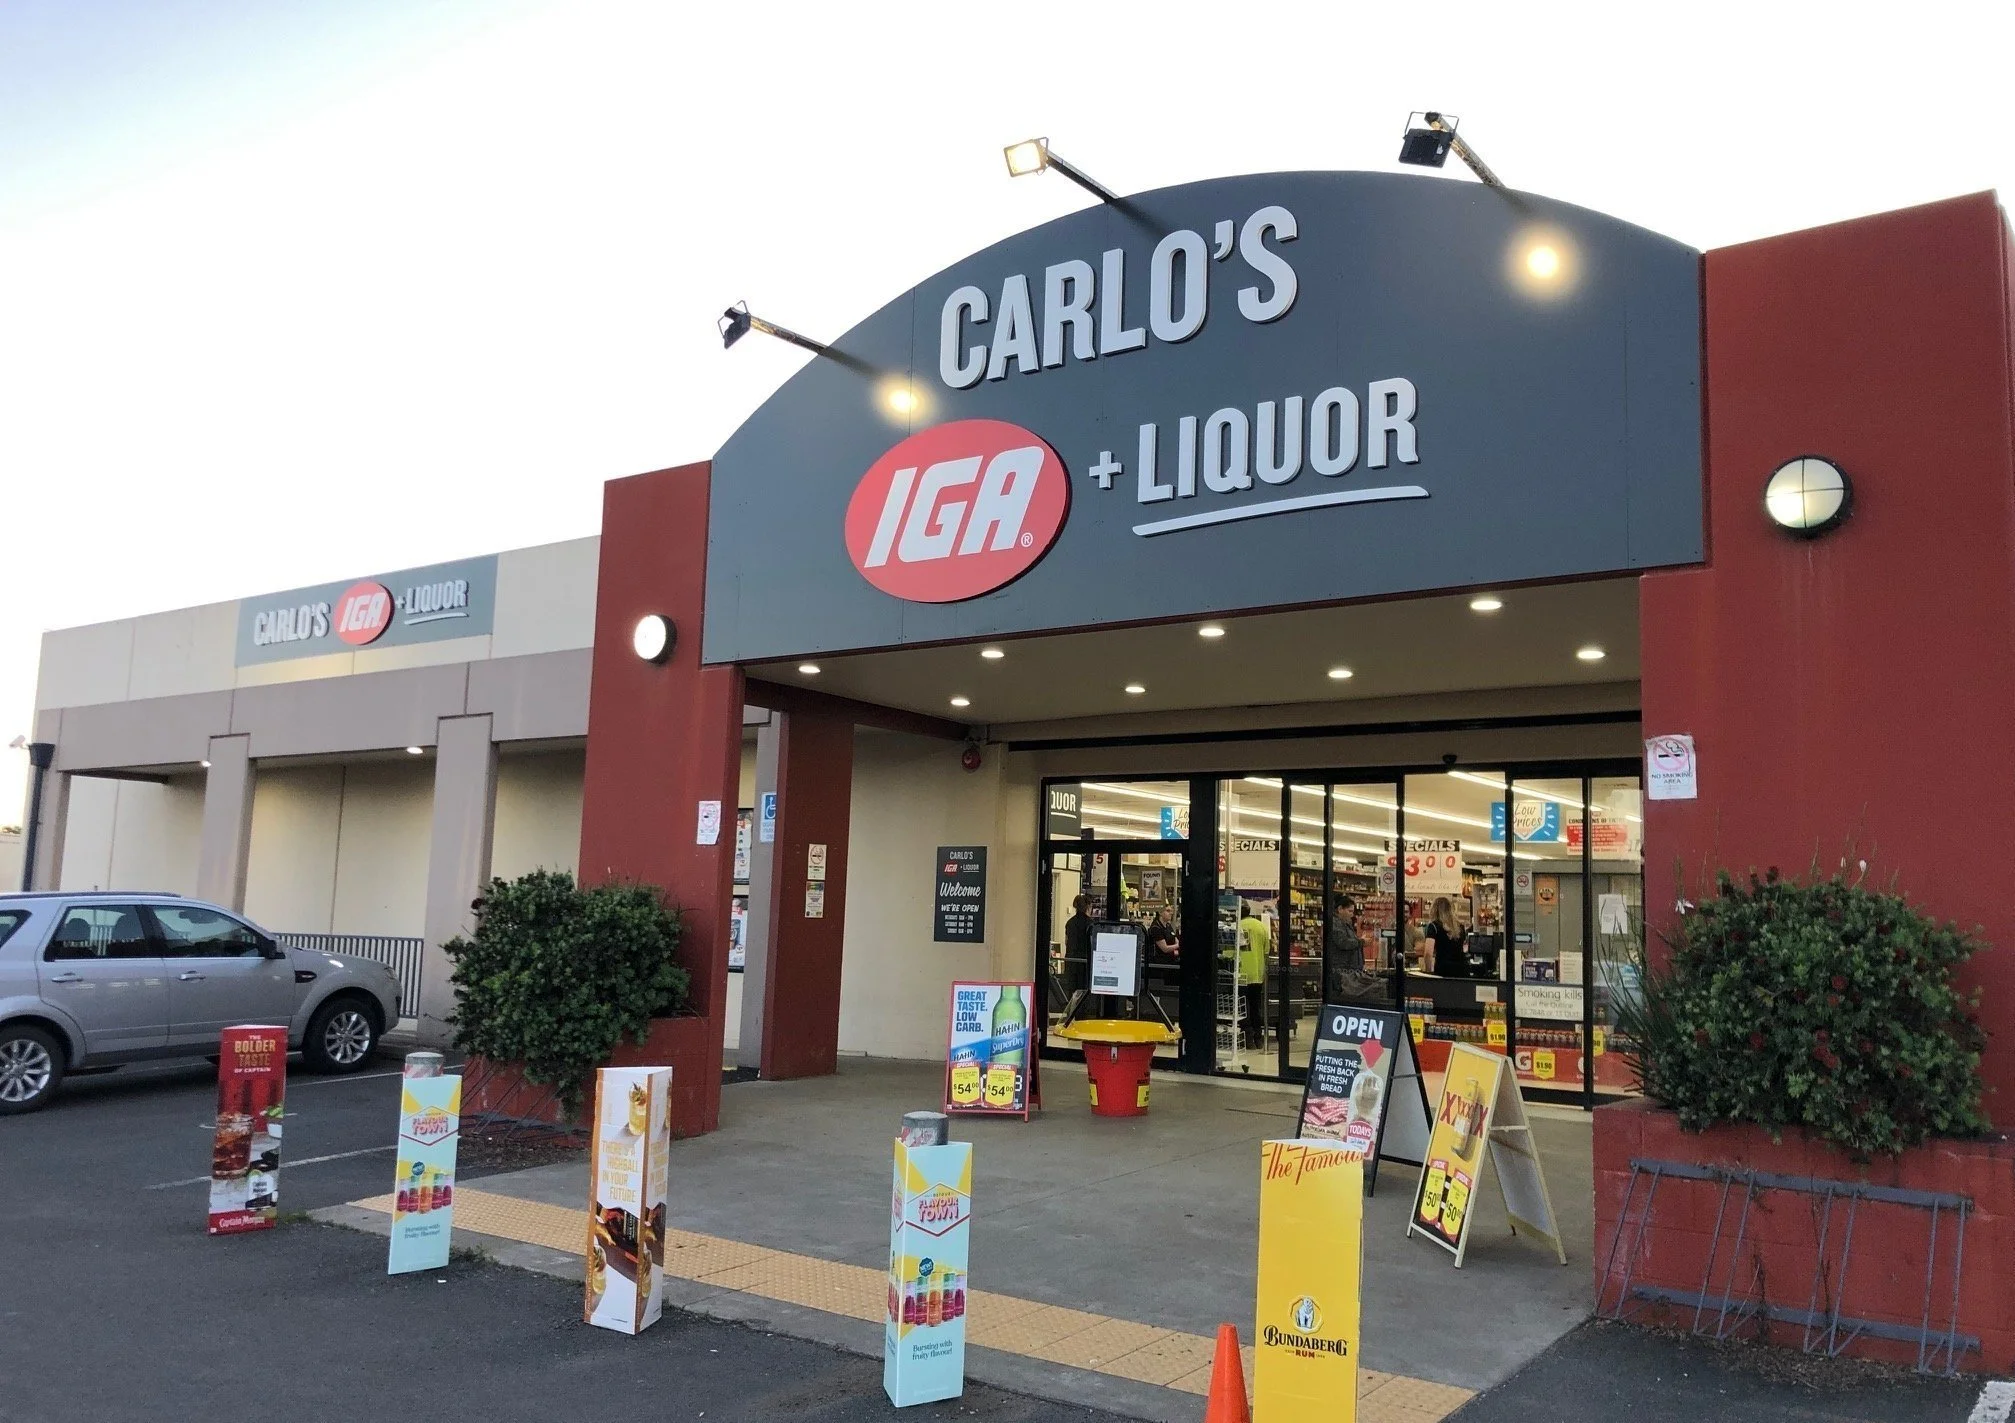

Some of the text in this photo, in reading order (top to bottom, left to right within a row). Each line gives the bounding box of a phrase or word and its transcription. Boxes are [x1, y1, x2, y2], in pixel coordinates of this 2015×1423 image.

[939, 205, 1298, 389] CARLO'S
[863, 445, 1045, 568] IGA
[1137, 376, 1419, 503] LIQUOR
[254, 602, 330, 645] CARLO'S
[339, 592, 387, 633] IGA
[405, 579, 468, 614] LIQUOR
[1514, 802, 1536, 816] Low
[1219, 840, 1276, 851] SECIALS
[1388, 840, 1456, 852] SECIALS
[949, 851, 974, 860] CARLO'S
[944, 864, 958, 872] IGA
[939, 881, 981, 897] Welcome
[941, 902, 980, 912] WE'RE OPEN
[957, 990, 987, 1001] GREAT
[1518, 988, 1583, 1001] Smoking kills
[957, 1001, 988, 1012] TASTE.
[956, 1011, 977, 1022] LOW
[955, 1022, 984, 1033] CARB.
[995, 1022, 1020, 1036] HAHN
[1332, 1015, 1384, 1040] OPEN
[234, 1040, 276, 1053] BOLDER
[239, 1053, 271, 1067] TASTE
[953, 1049, 976, 1061] HAHN
[1315, 1054, 1358, 1069] PUTTING THE
[1315, 1064, 1355, 1078] FRESH BACK
[1327, 1075, 1348, 1085] FRESH
[1320, 1083, 1343, 1094] BREAD
[412, 1123, 449, 1135] TOWN
[1349, 1124, 1372, 1138] TODAYS
[1262, 1143, 1293, 1180] The
[610, 1186, 636, 1203] FUTURE
[918, 1197, 959, 1209] FLAVOUR
[918, 1206, 959, 1222] TOWN
[913, 1339, 952, 1352] Bursting with
[1264, 1324, 1347, 1357] BUNDABERG
[912, 1351, 929, 1360] fruity
[1295, 1349, 1315, 1358] RUM
